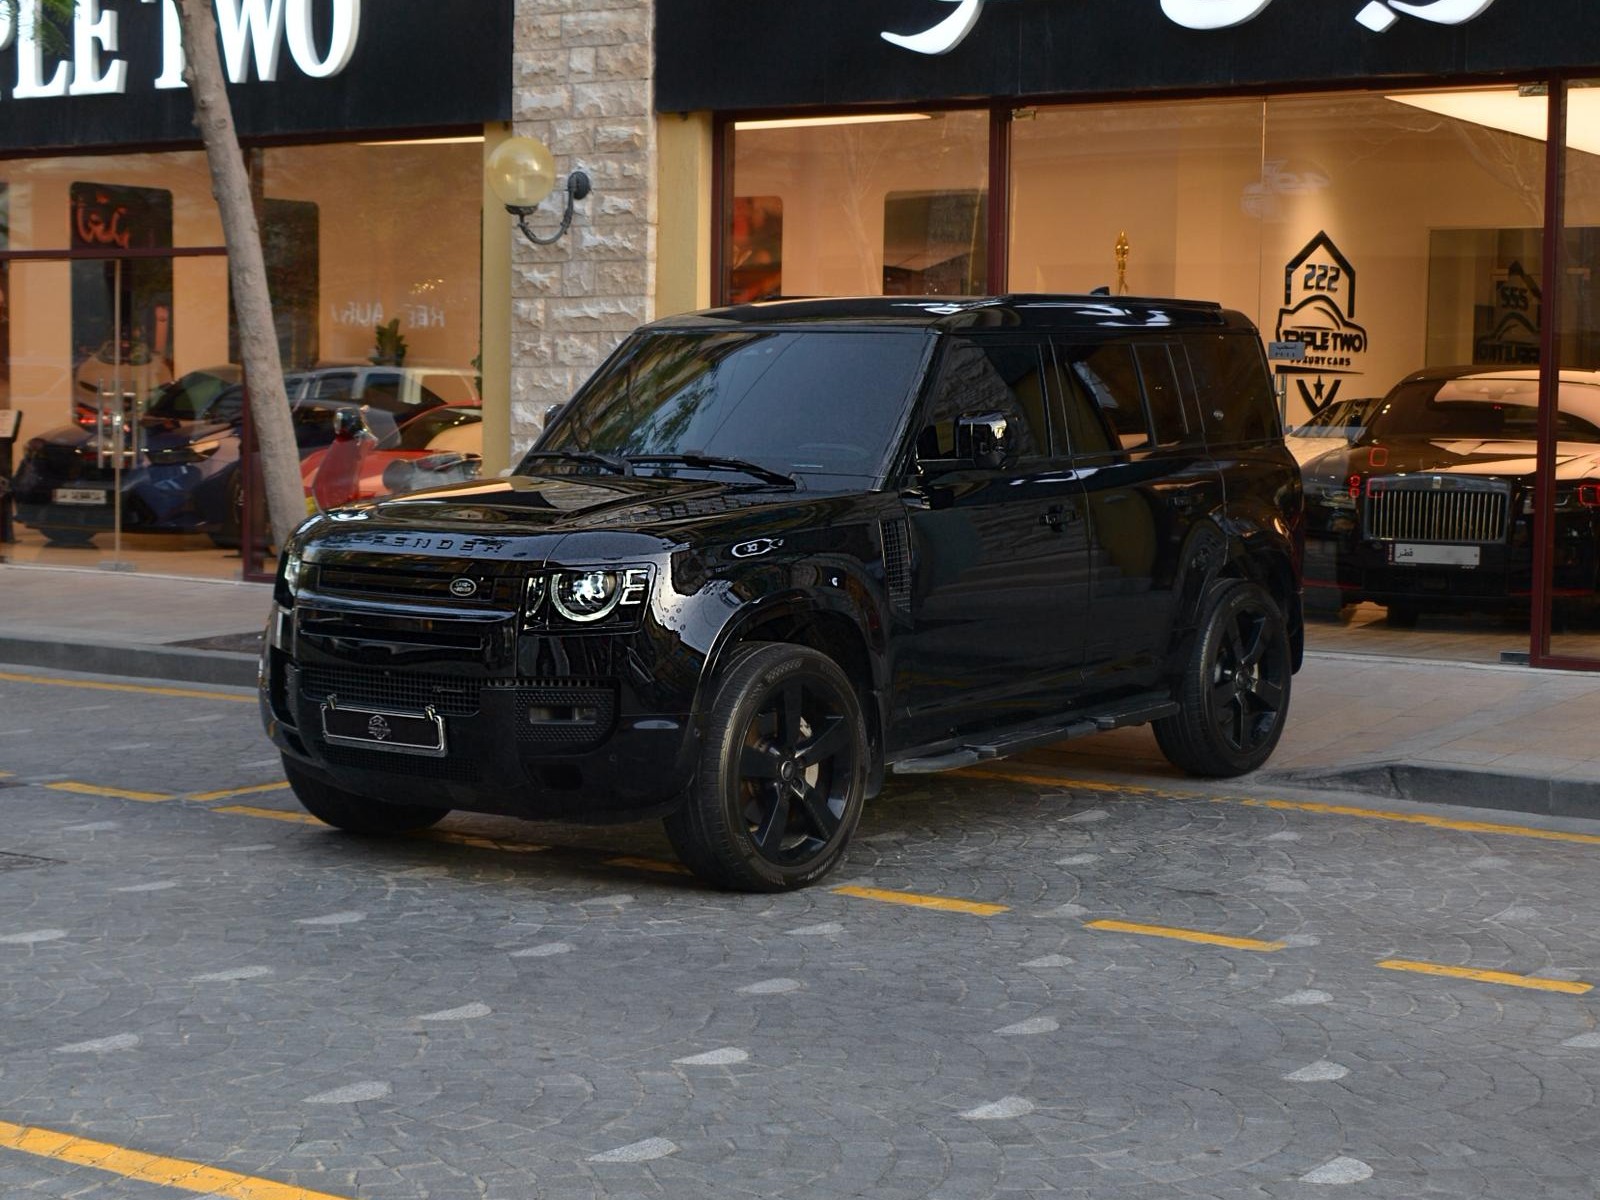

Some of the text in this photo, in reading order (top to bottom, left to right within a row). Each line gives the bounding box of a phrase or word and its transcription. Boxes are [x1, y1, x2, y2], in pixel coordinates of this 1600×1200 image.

[0, 0, 128, 99] LE
[1303, 264, 1341, 292] 222
[1330, 332, 1363, 353] TWO
[1327, 357, 1351, 366] CARS
